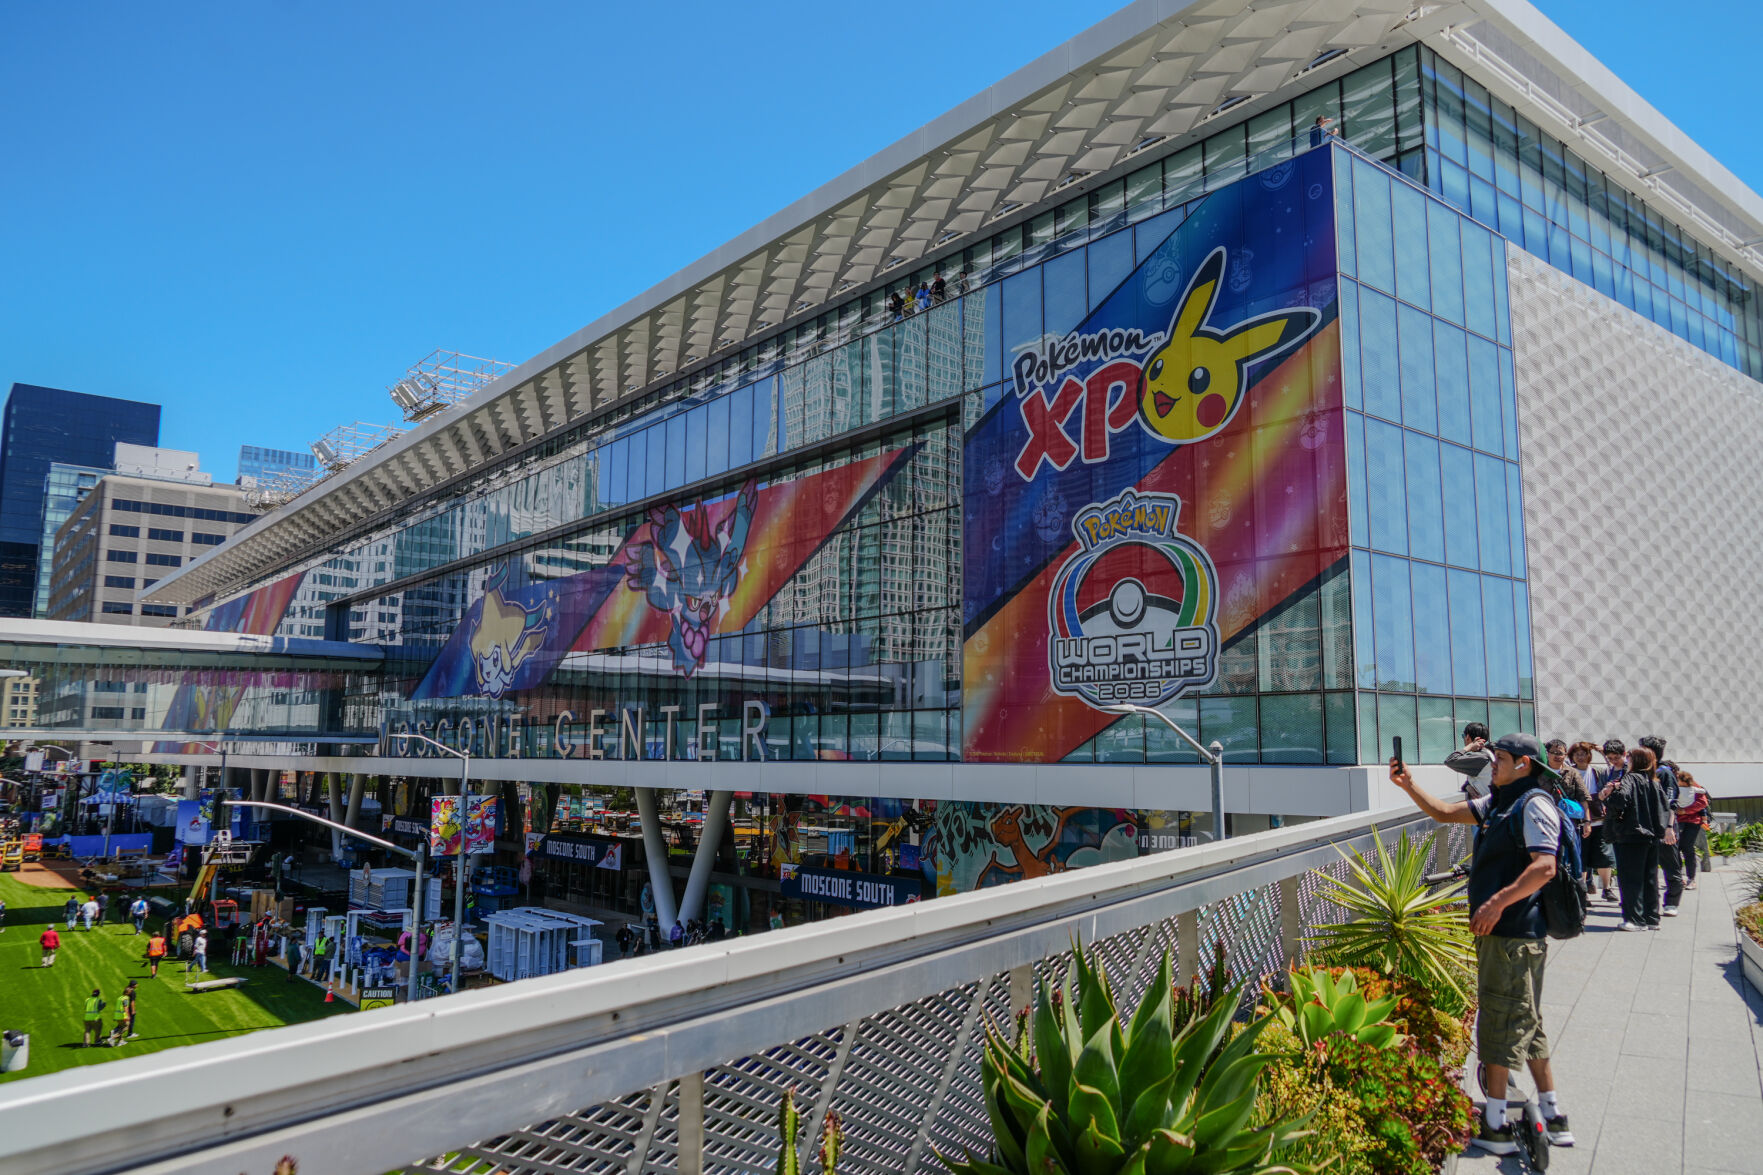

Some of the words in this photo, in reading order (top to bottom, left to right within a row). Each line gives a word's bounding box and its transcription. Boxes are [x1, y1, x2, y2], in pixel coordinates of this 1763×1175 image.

[1014, 331, 1152, 394] Pokémon
[1057, 628, 1209, 666] WORLD
[1059, 659, 1206, 683] CHAMPIONSHIPS
[1098, 681, 1161, 699] 2026
[378, 713, 522, 758] MOSCONE
[555, 700, 768, 761] CENTER
[546, 840, 574, 857] MOSCONE
[575, 844, 596, 860] SOUTH
[801, 873, 852, 899] MOSCONE
[856, 880, 895, 905] SOUTH
[362, 990, 393, 998] CAUTION
